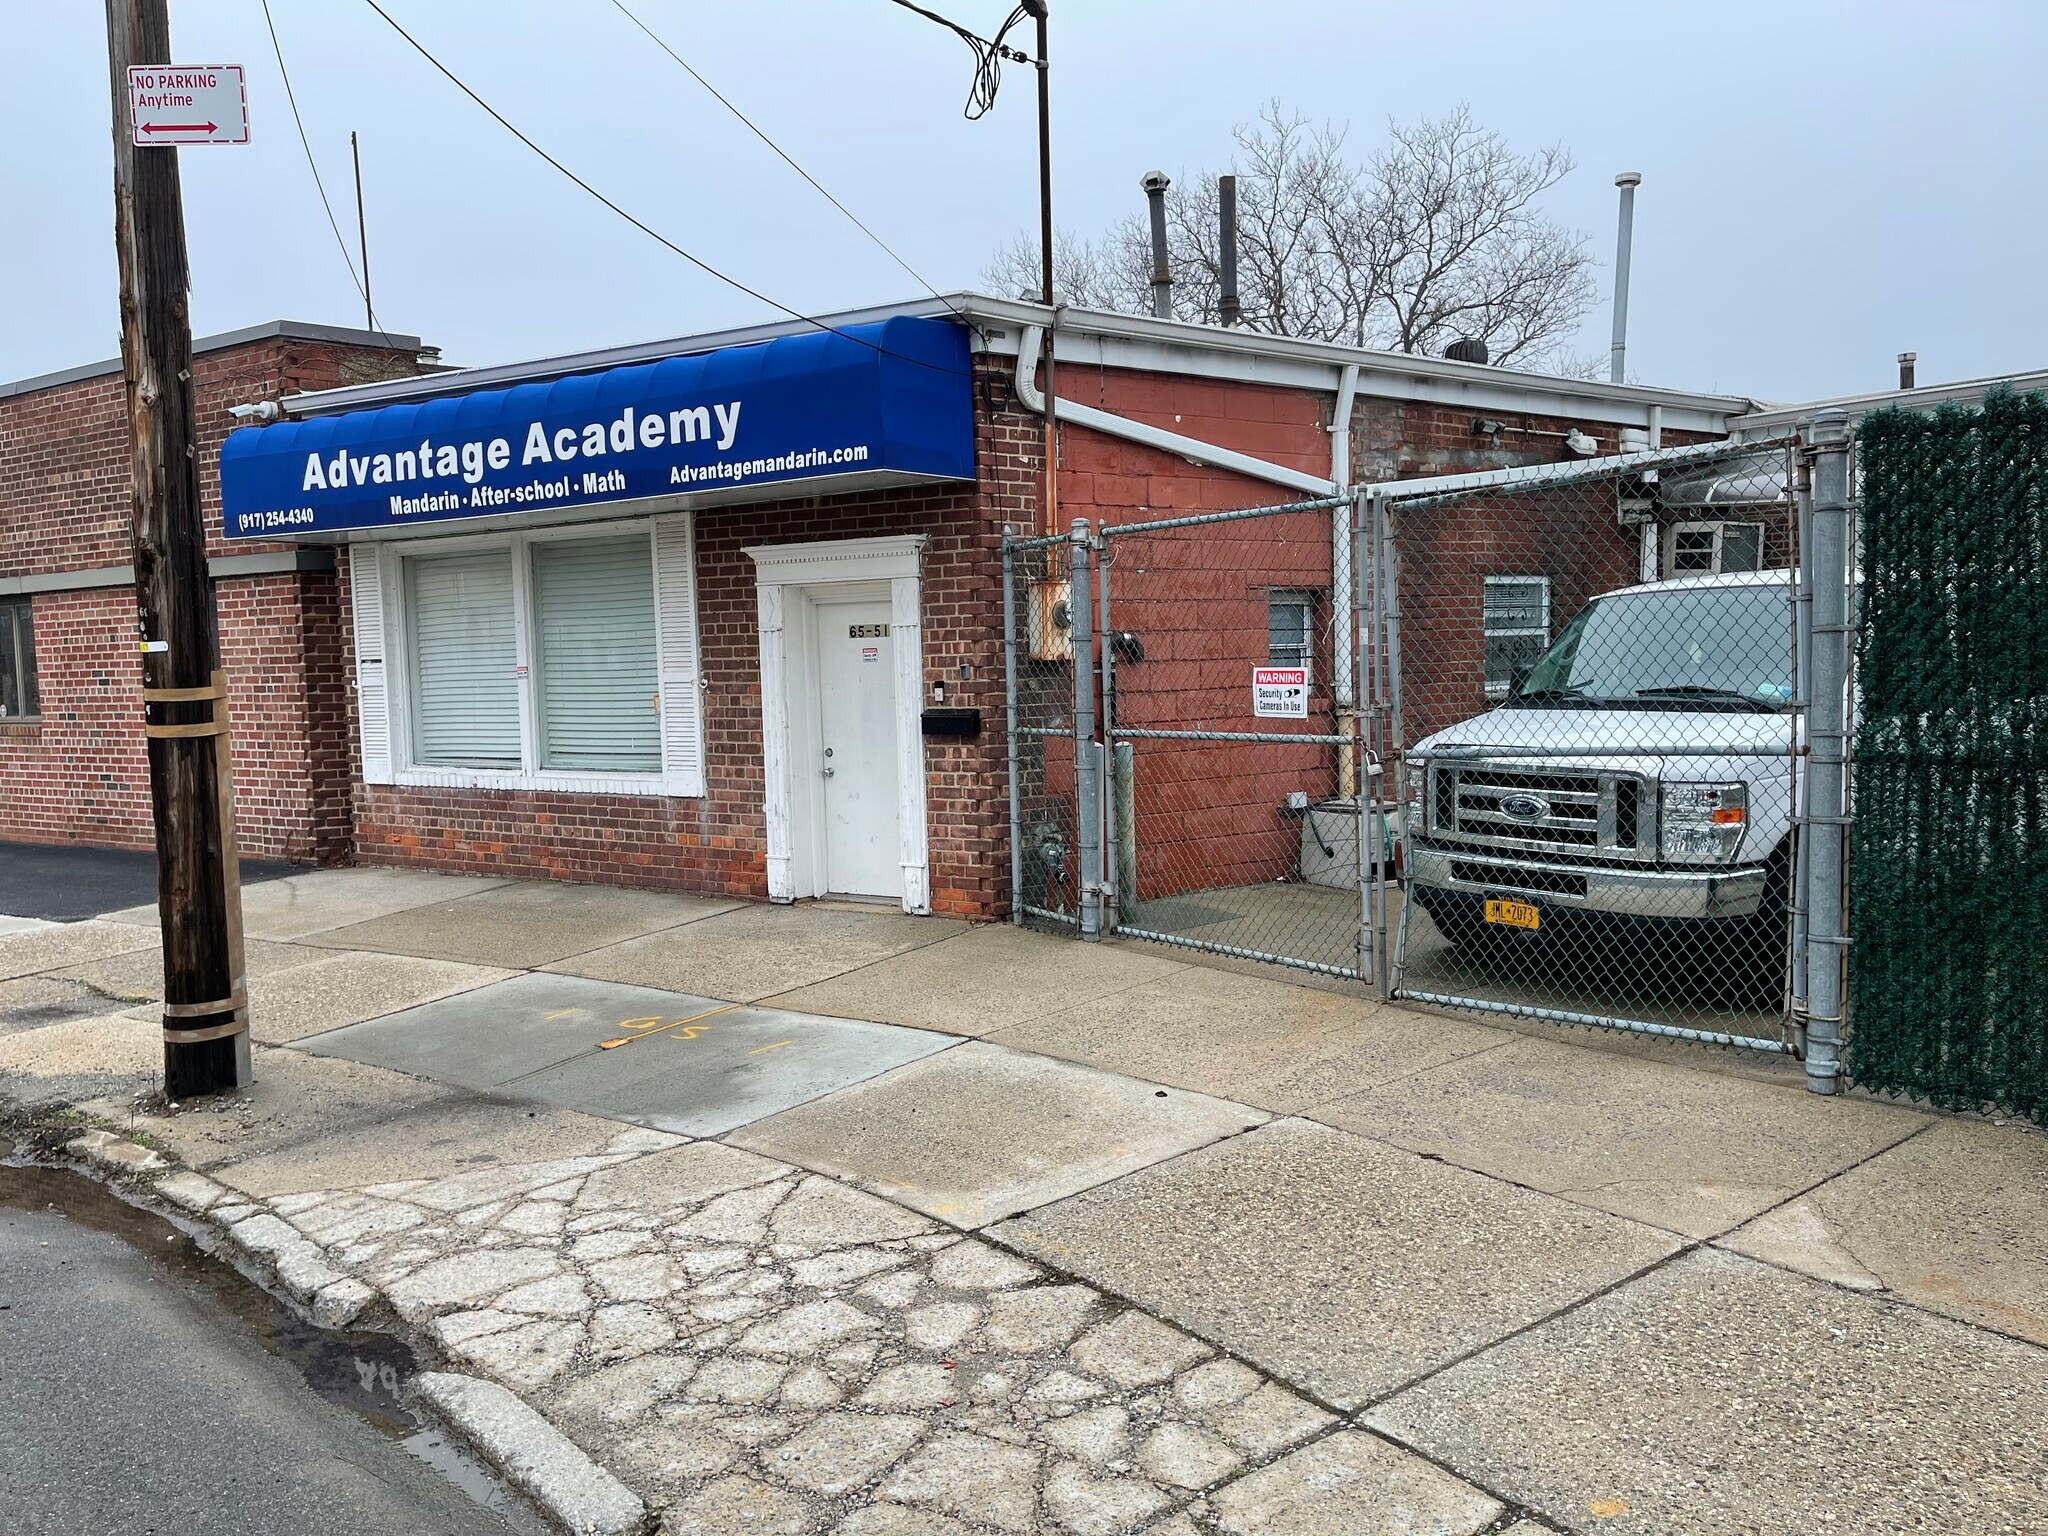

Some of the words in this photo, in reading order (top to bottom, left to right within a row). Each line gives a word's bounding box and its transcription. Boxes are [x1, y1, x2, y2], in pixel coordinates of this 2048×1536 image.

[136, 75, 154, 89] NO
[159, 75, 216, 88] PARKING
[139, 93, 193, 110] Anytime
[302, 438, 510, 492] Advantage
[521, 401, 742, 466] Academy
[670, 444, 868, 485] Advantagemandarin.com
[390, 490, 460, 516] Mandarin
[470, 475, 570, 508] After-school
[583, 469, 626, 495] Math
[238, 511, 265, 533] (917)
[265, 507, 314, 527] 254-4340
[850, 625, 888, 638] 65-51
[1258, 672, 1302, 684] WARNING
[1259, 688, 1283, 700] Security
[1260, 701, 1282, 711] Cameras
[1284, 701, 1289, 711] In
[1291, 701, 1301, 711] Use
